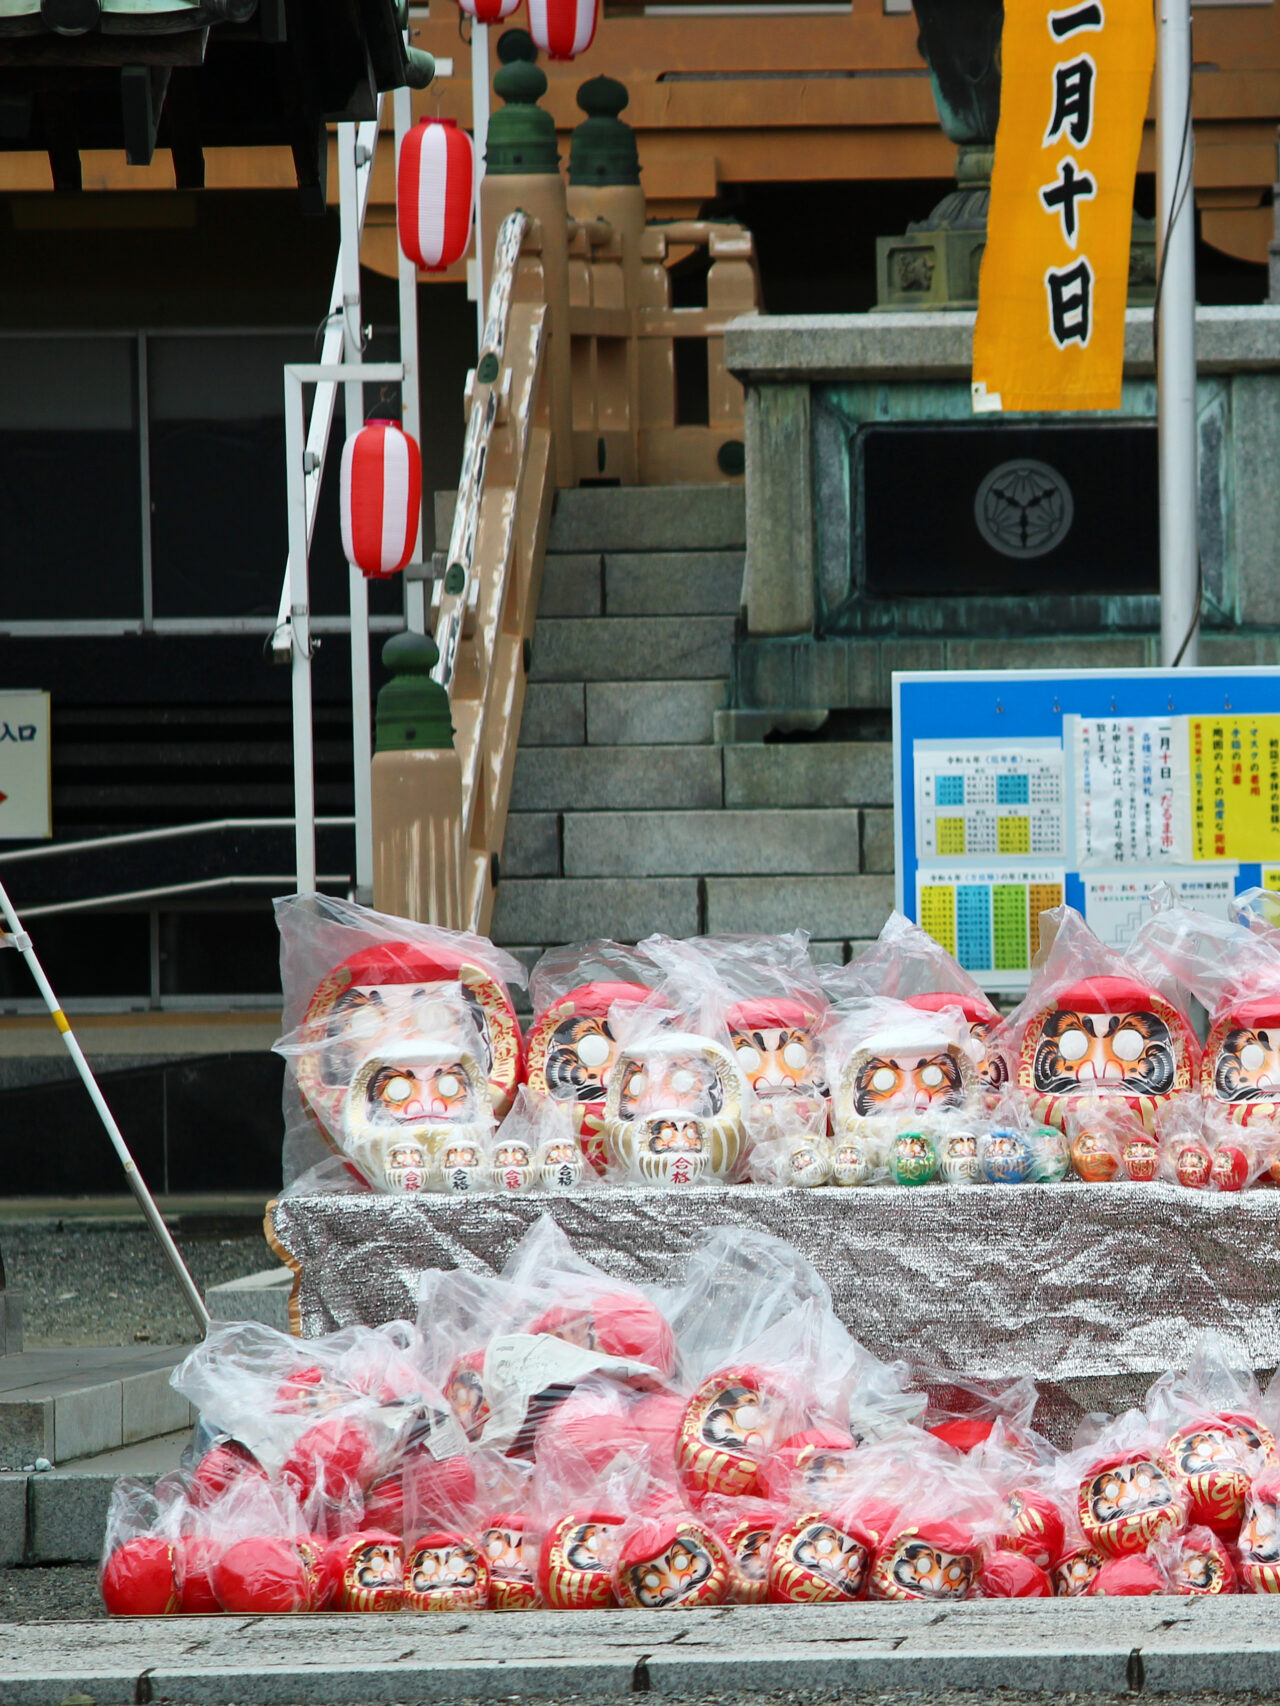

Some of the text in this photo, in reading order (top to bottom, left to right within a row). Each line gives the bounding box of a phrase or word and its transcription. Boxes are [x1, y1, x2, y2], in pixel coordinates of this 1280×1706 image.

[1041, 2, 1104, 349] 一月十日
[404, 1171, 420, 1190] 合格
[452, 1169, 470, 1190] 合格
[505, 1170, 521, 1189] 合格
[557, 1164, 574, 1186] 合格
[671, 1157, 693, 1184] 合格
